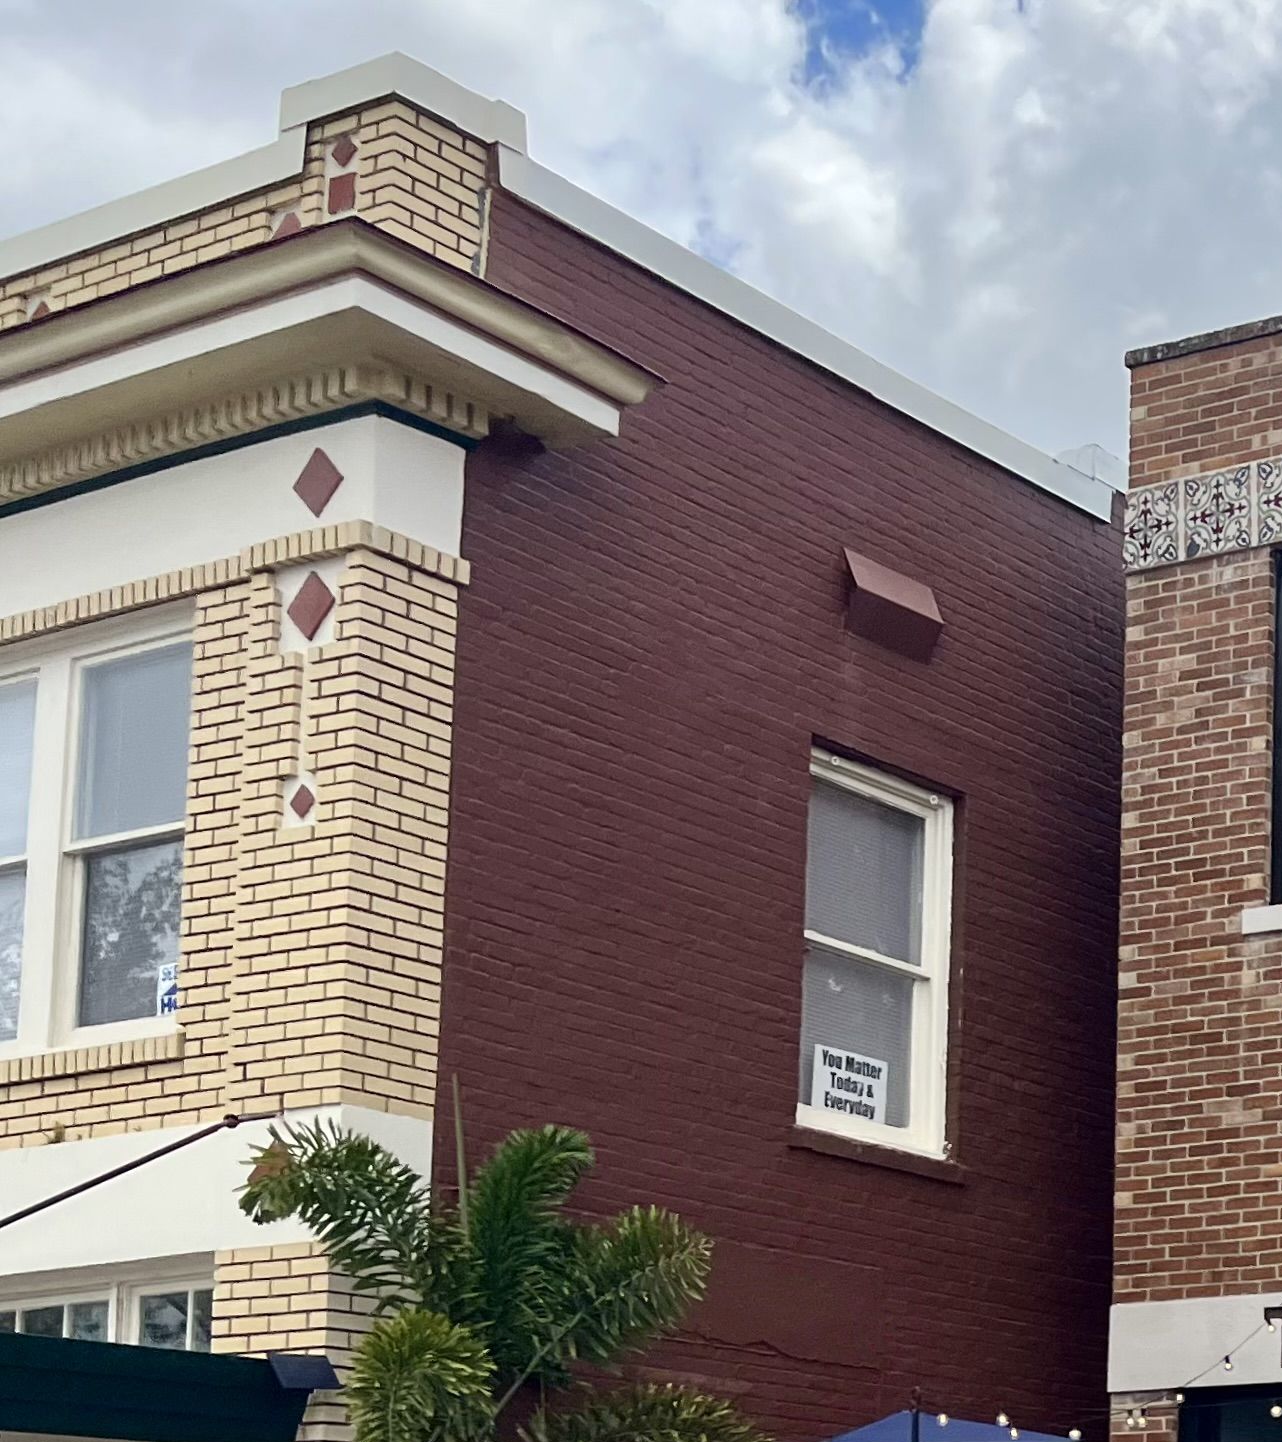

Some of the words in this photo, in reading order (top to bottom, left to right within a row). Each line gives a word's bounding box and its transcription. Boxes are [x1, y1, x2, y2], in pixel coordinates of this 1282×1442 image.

[822, 1049, 842, 1069] You
[845, 1055, 882, 1080] Matter
[830, 1071, 864, 1097] Today
[866, 1084, 874, 1098] &
[824, 1090, 876, 1120] Everyday
